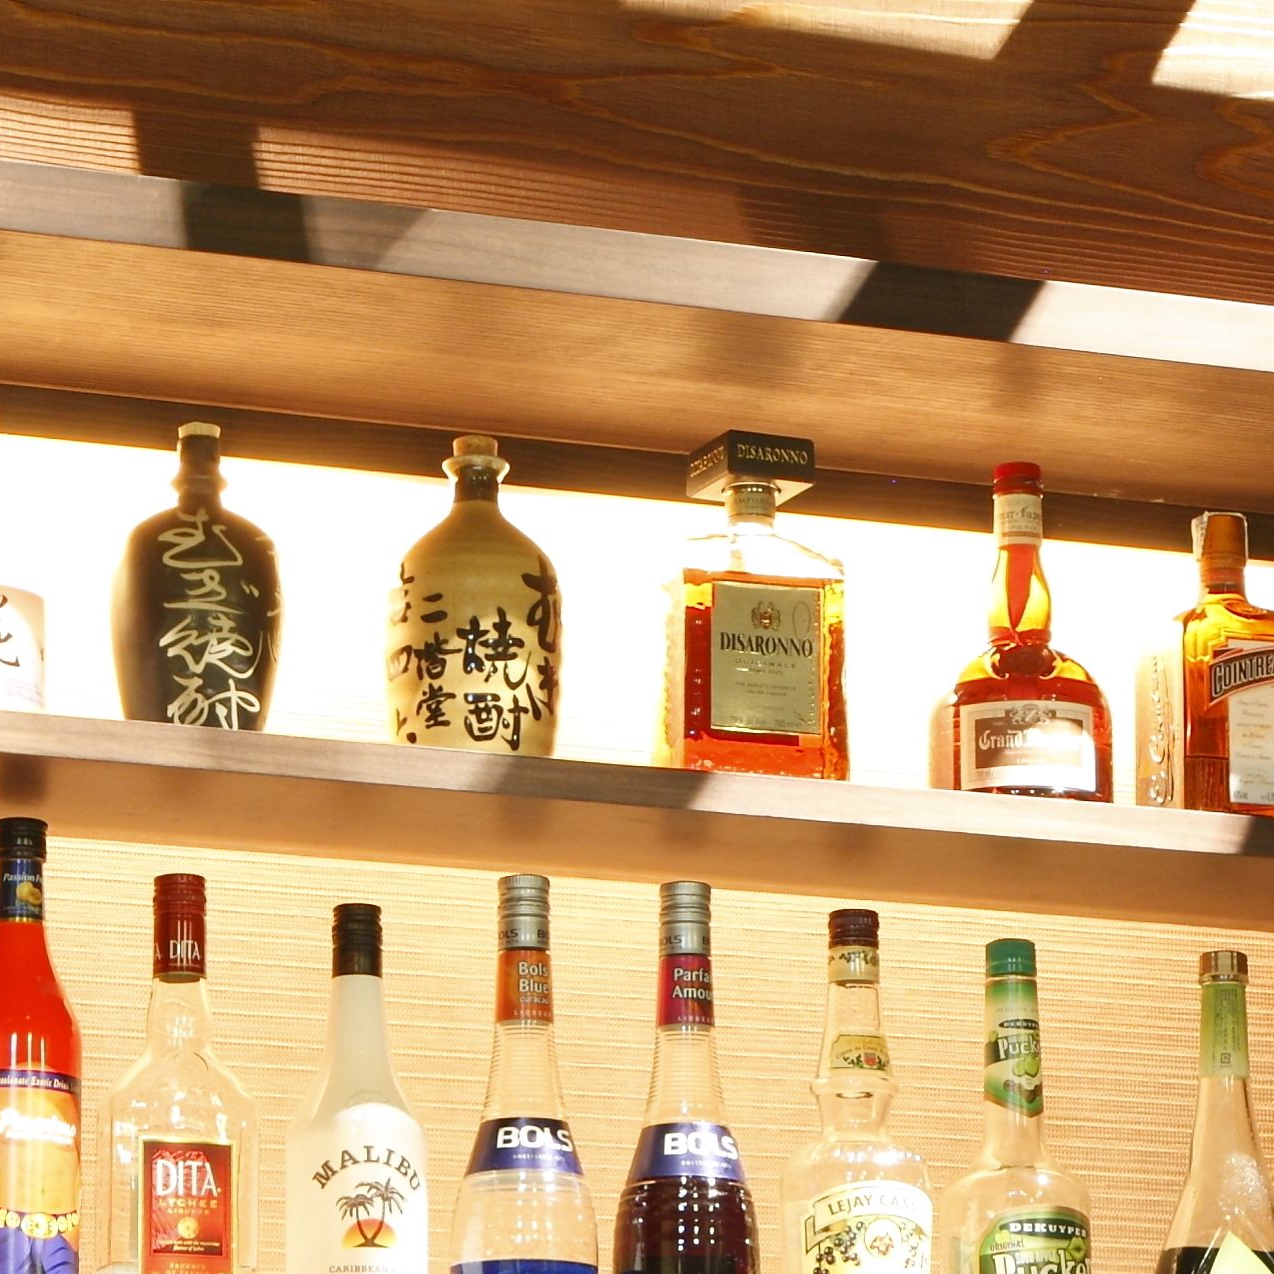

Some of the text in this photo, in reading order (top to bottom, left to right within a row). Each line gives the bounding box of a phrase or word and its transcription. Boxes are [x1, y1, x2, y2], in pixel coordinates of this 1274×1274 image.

[736, 443, 809, 465] DISARONNO
[720, 631, 813, 658] DISARONNO
[414, 593, 463, 729] 二階堂
[456, 607, 532, 751] 焼酎
[169, 939, 201, 960] DITA
[518, 961, 550, 977] Bols
[518, 978, 550, 994] Blue
[496, 1125, 573, 1152] BOLS
[664, 1131, 739, 1160] BOLS
[156, 1158, 218, 1197] DITA
[312, 1145, 421, 1190] MALIBU
[158, 1198, 219, 1208] LYCHEE
[827, 1194, 874, 1215] LEJAY
[990, 1239, 1025, 1252] ORIGINAL
[329, 1265, 389, 1274] CARIBBEAN
